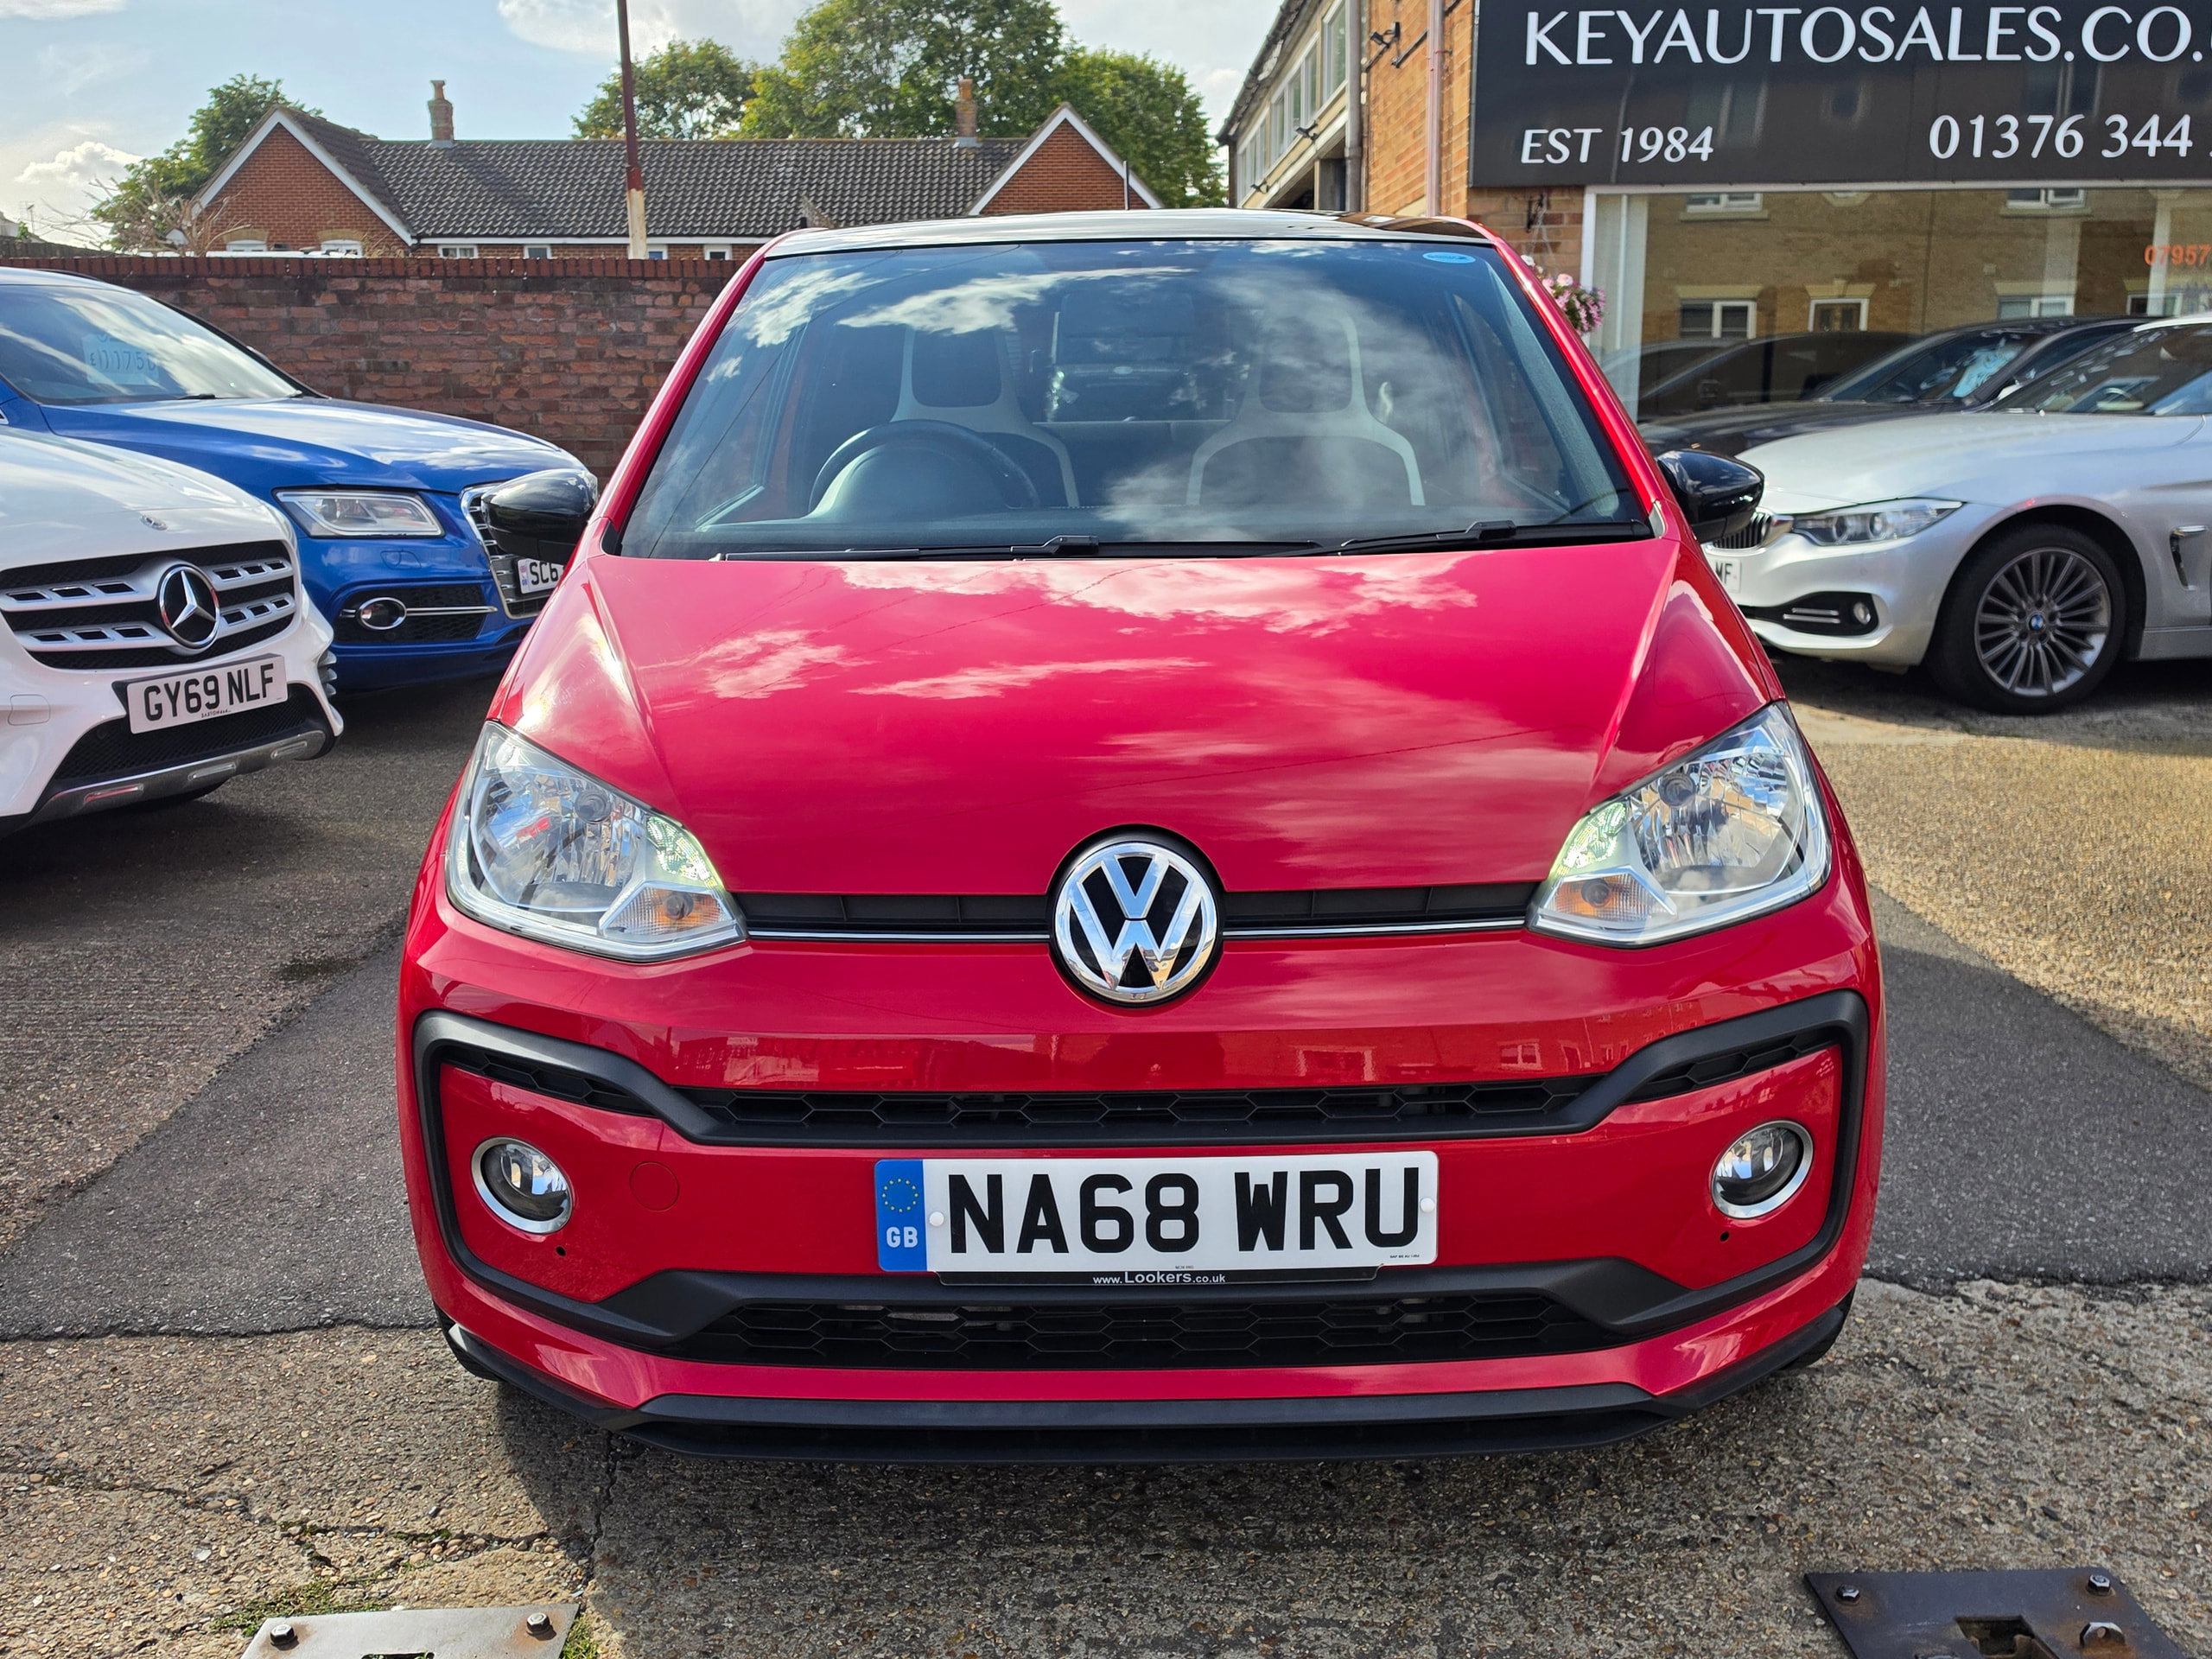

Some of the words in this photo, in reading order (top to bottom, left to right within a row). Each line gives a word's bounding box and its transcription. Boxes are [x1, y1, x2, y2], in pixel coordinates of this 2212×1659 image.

[1525, 5, 2212, 66] KEYAUTOSALES.CO.
[1521, 128, 1604, 164] EST
[1620, 126, 1714, 164] 1984
[1929, 113, 2084, 159] 01376
[2101, 113, 2193, 158] 344
[2145, 245, 2211, 266] 07957
[529, 561, 559, 586] SC6
[143, 675, 220, 721] GY69
[226, 663, 274, 705] NLF
[947, 1173, 1200, 1255] NA68
[1233, 1166, 1420, 1252] WRU
[886, 1226, 918, 1249] GB
[1092, 1270, 1226, 1284] www.Lookers.co.uk
